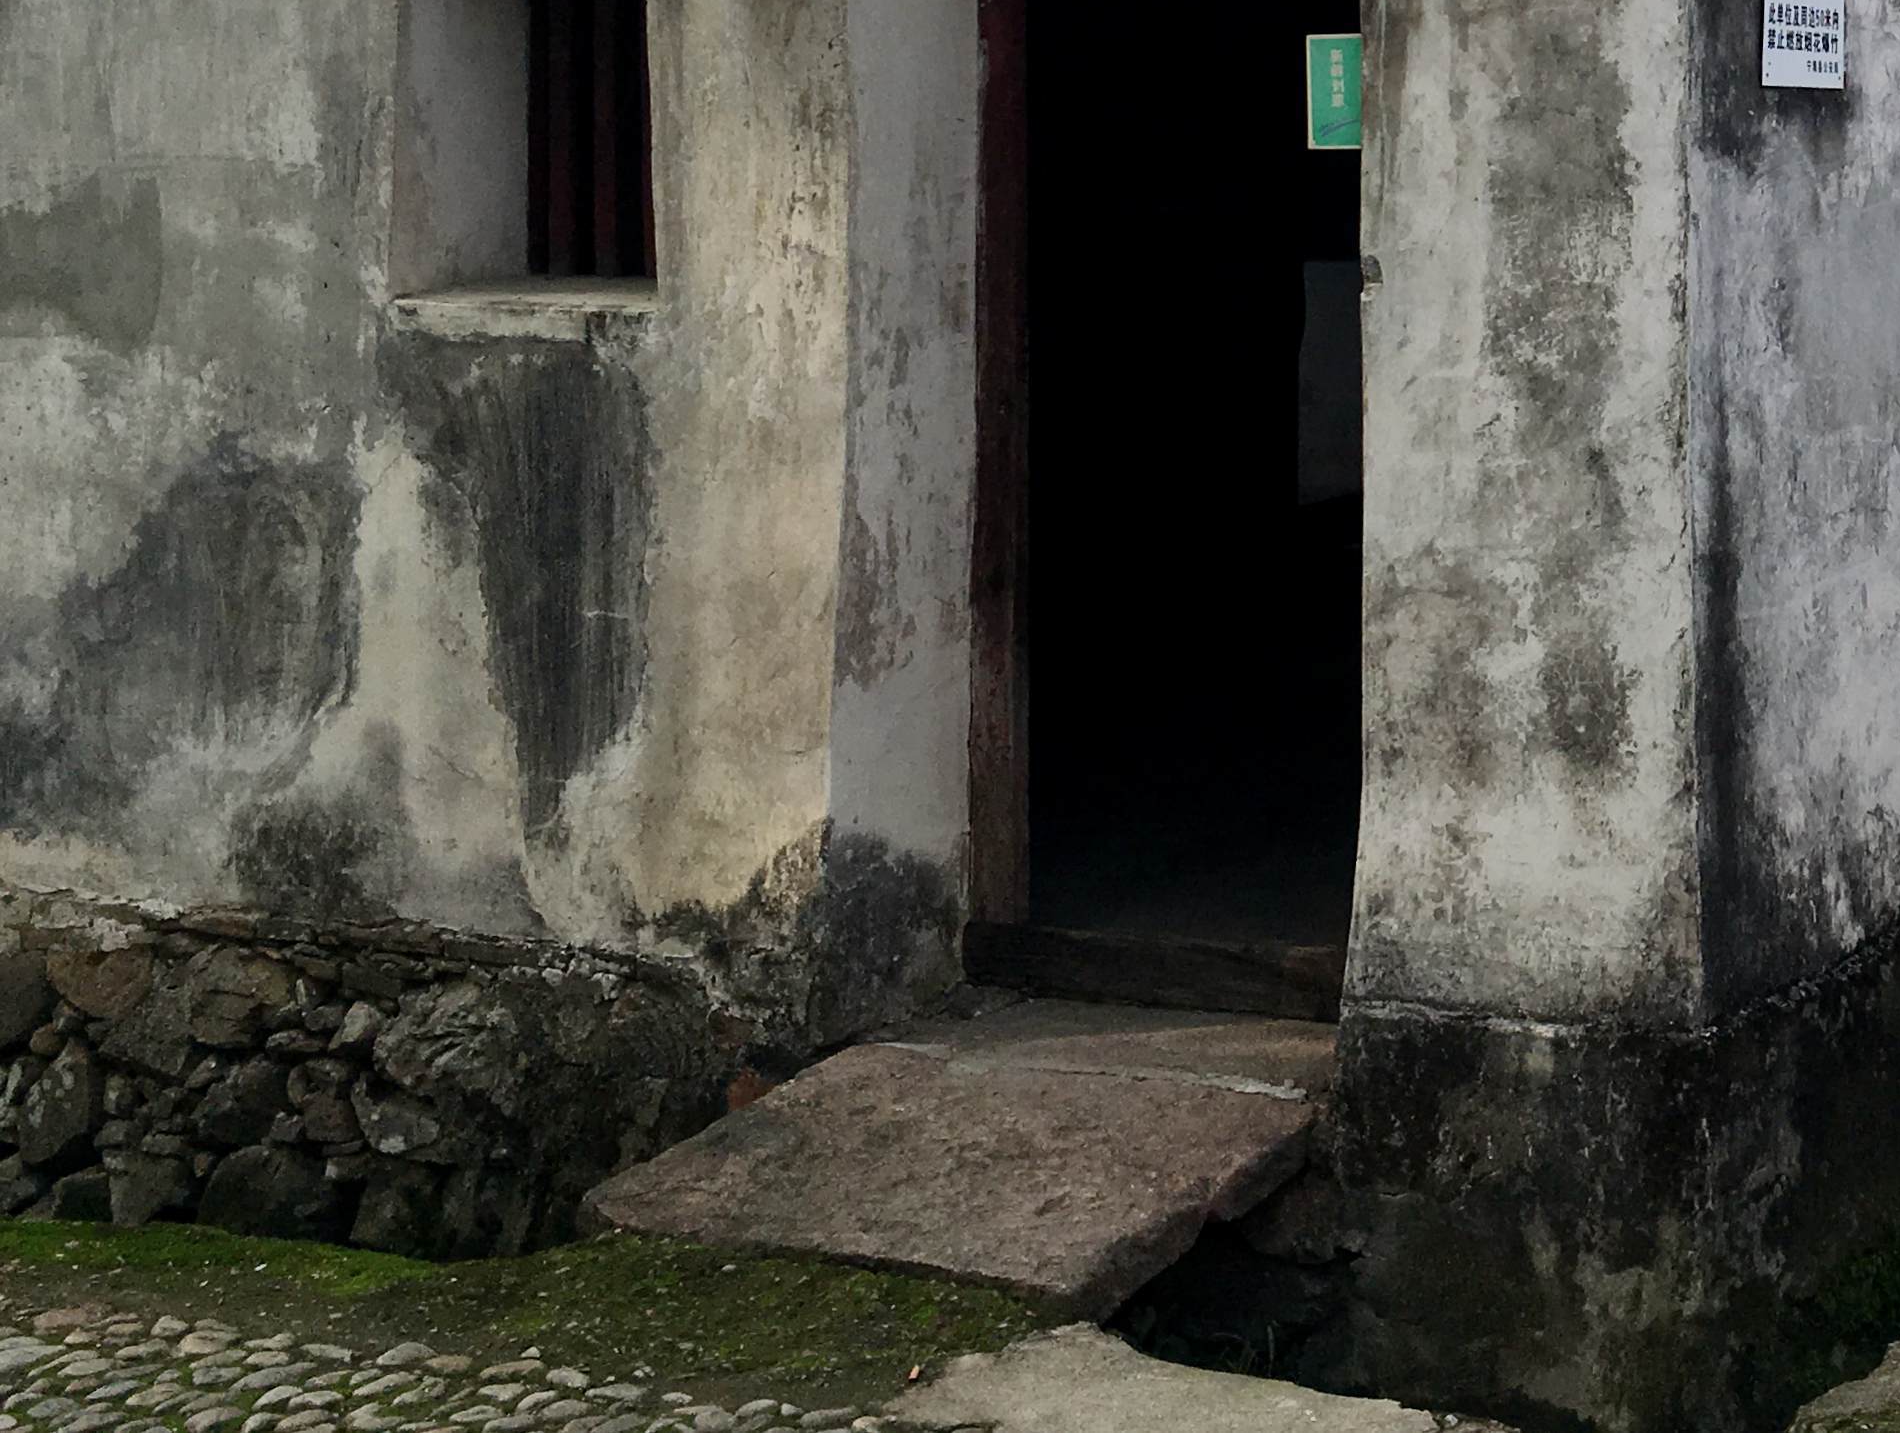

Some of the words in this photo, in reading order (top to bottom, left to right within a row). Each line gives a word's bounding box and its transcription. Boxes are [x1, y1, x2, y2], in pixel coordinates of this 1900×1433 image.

[1768, 29, 1838, 54] 禁止燃放烟花爆竹
